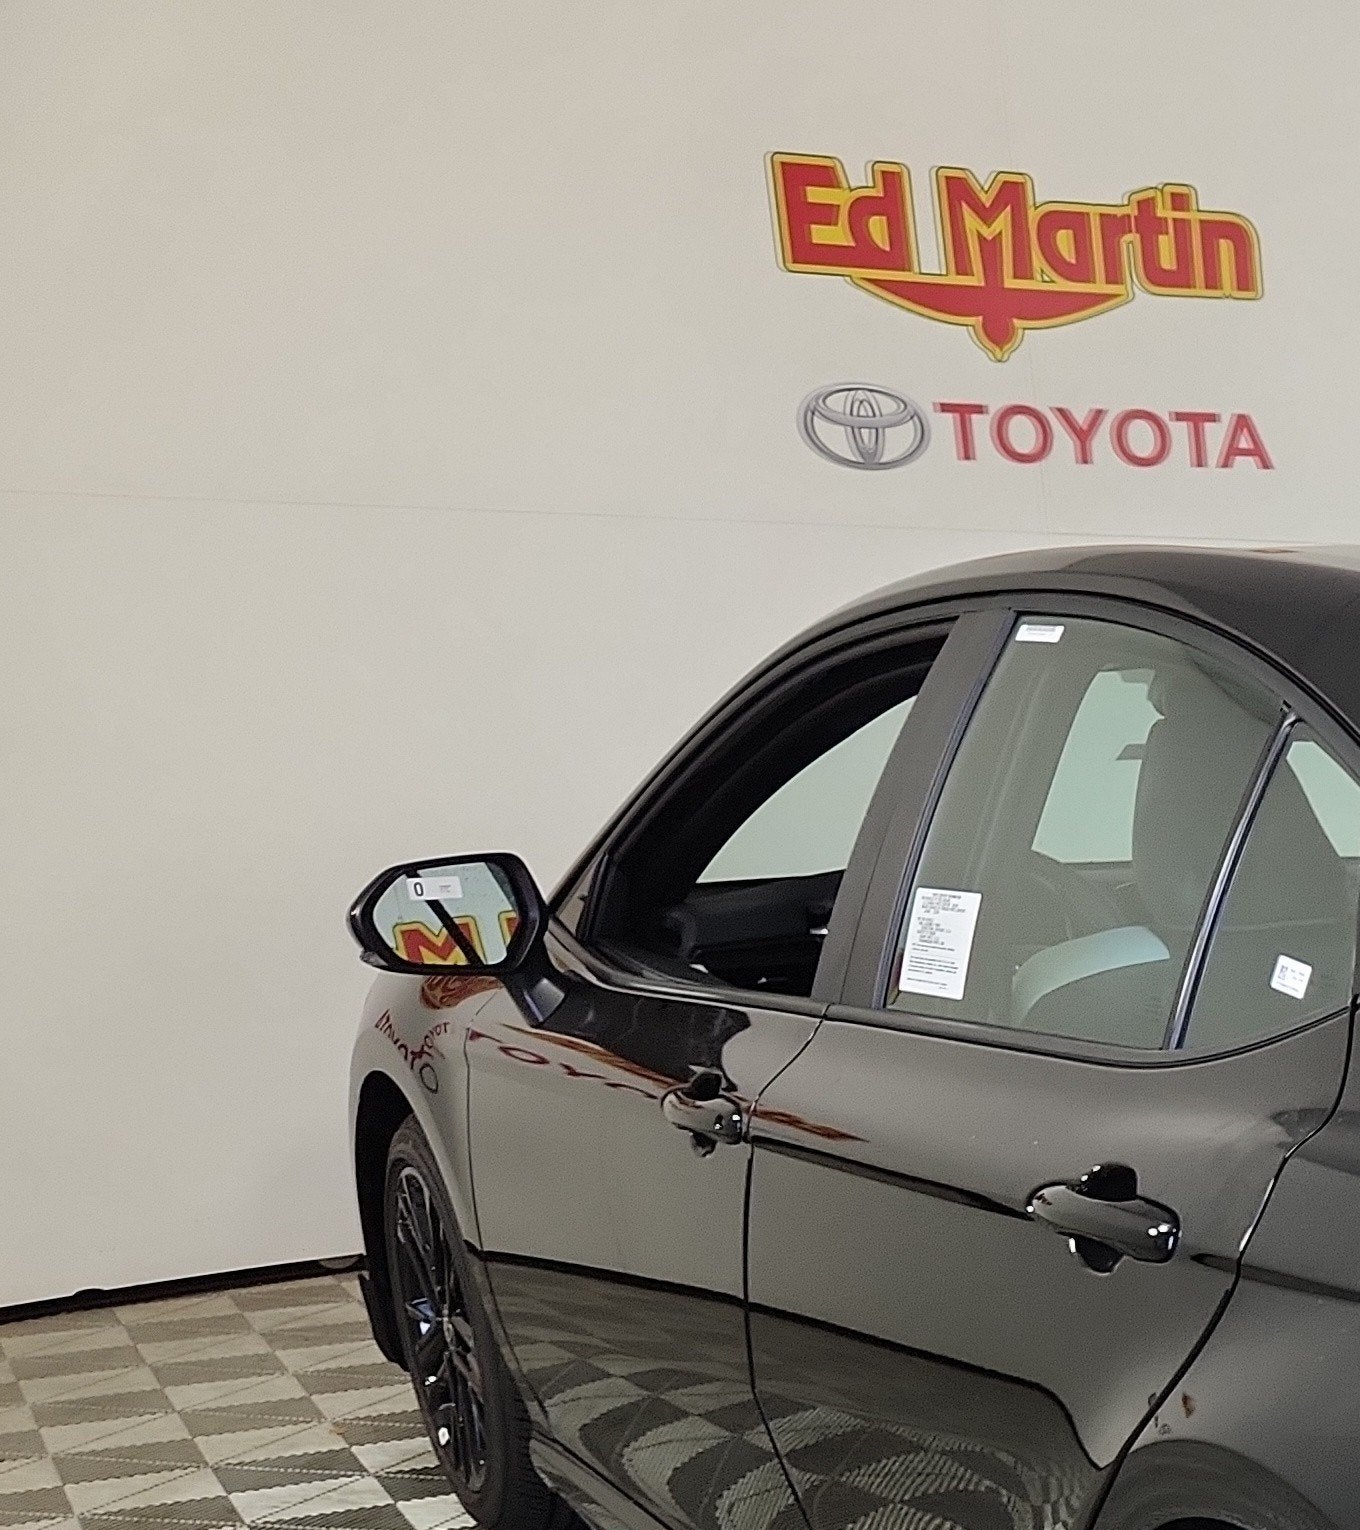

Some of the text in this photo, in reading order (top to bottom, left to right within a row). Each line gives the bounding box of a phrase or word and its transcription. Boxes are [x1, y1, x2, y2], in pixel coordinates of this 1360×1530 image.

[772, 153, 1263, 300] Ed Martin
[932, 401, 1275, 471] TOYOTA
